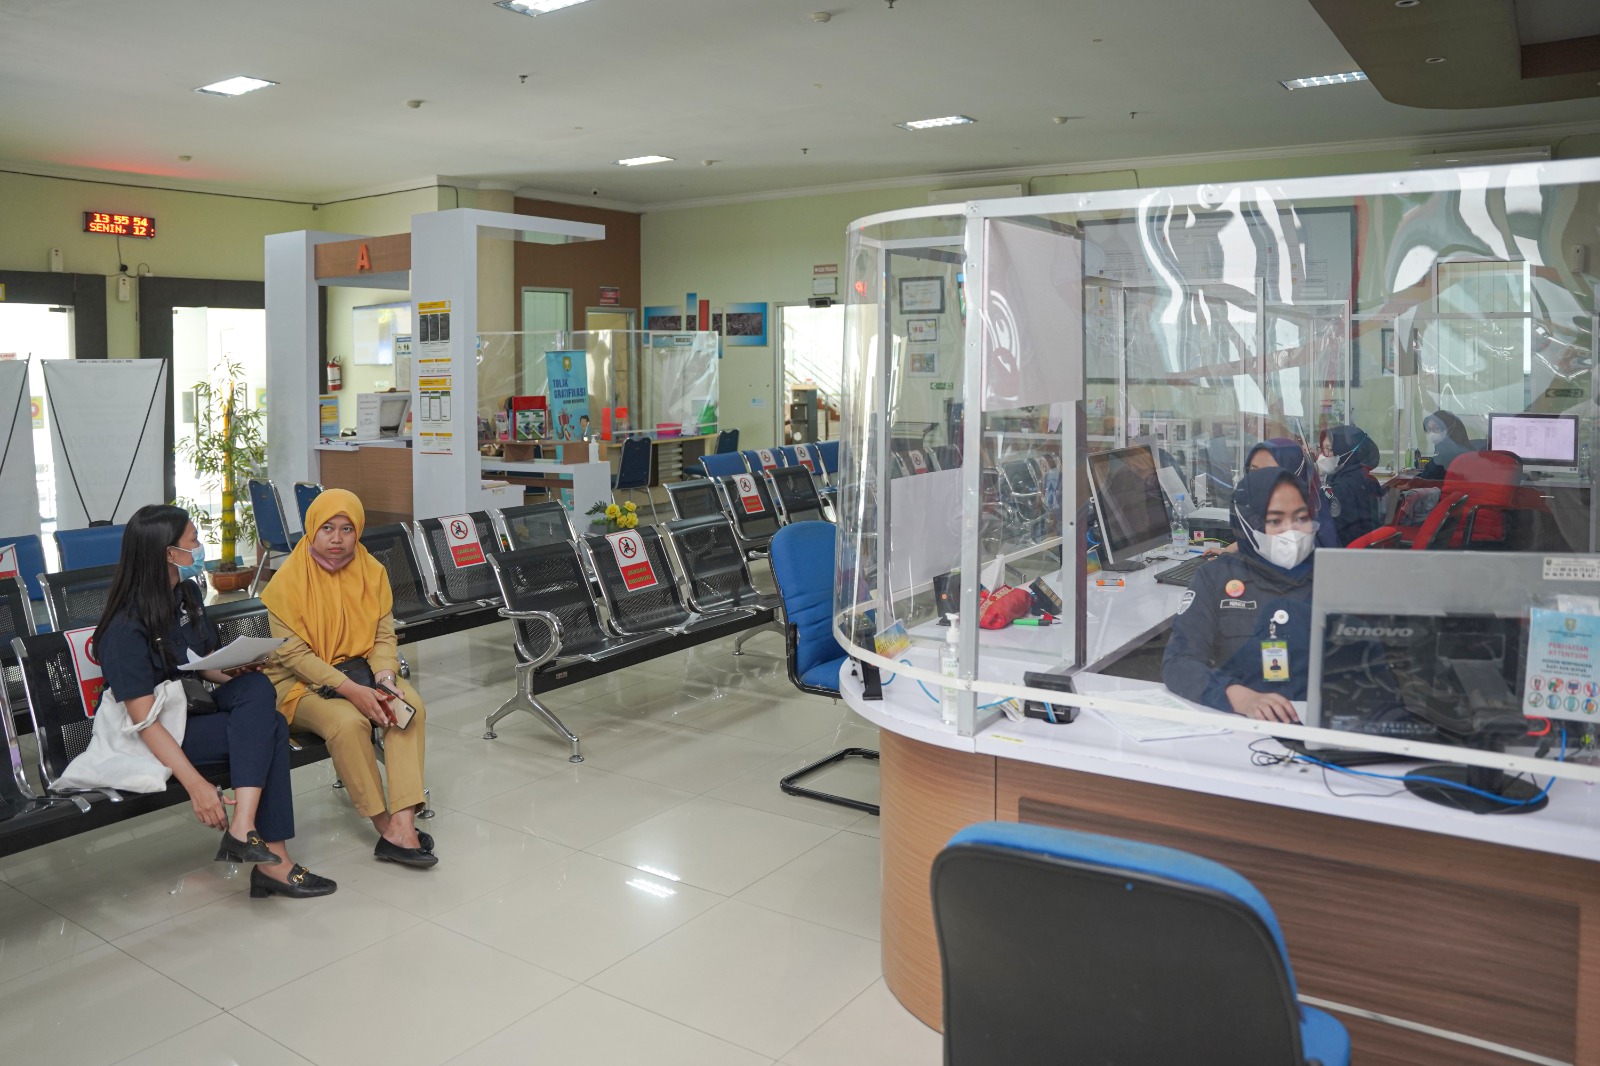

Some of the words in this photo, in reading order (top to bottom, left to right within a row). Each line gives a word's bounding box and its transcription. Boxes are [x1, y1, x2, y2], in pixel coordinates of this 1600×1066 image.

[93, 213, 110, 223] 13
[114, 215, 129, 225] 55
[133, 217, 148, 227] 54
[133, 226, 146, 236] 12
[356, 243, 372, 271] A
[552, 378, 569, 388] TOLAK
[457, 547, 476, 555] JANGAN
[628, 567, 647, 576] JANGAN
[1336, 623, 1414, 637] lenovo
[1548, 642, 1589, 652] PERHATIAN
[1548, 650, 1589, 660] ATTENTION
